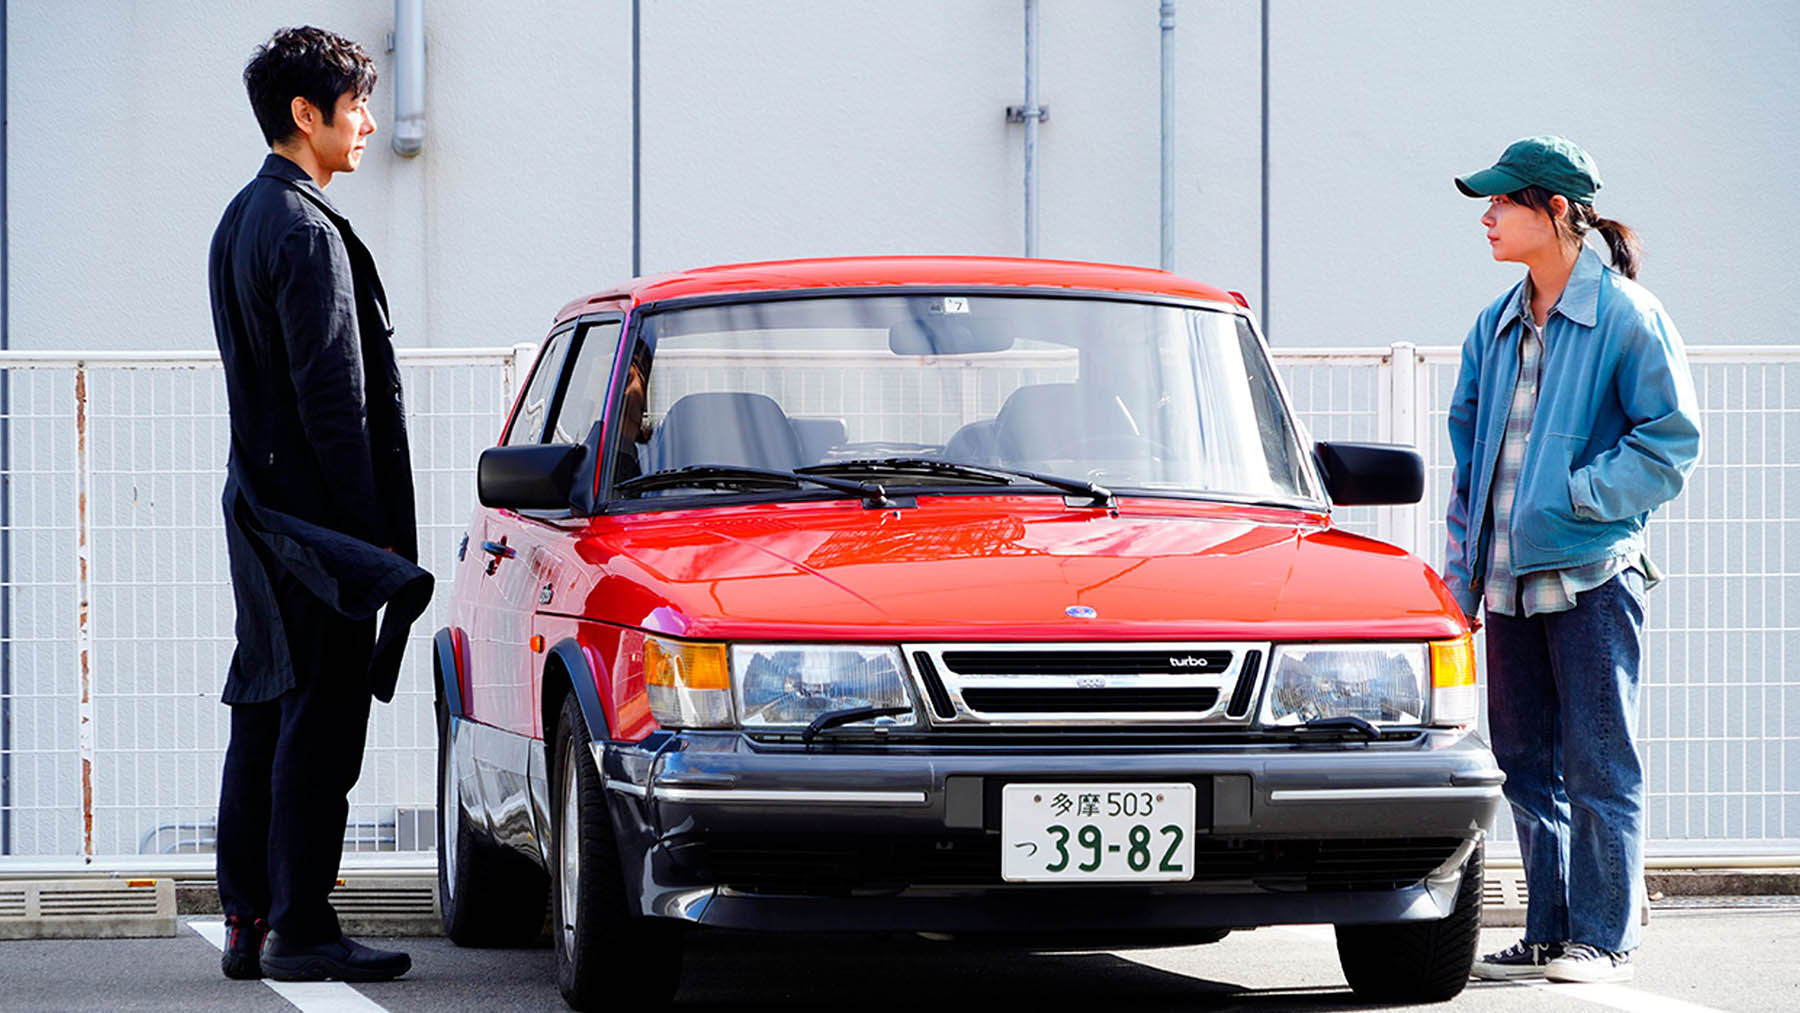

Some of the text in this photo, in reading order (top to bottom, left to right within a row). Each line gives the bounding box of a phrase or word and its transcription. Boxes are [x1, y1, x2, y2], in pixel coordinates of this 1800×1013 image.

[1170, 655, 1208, 667] turbo
[1050, 792, 1153, 817] 多摩 503
[1014, 824, 1184, 873] つ 39-82
